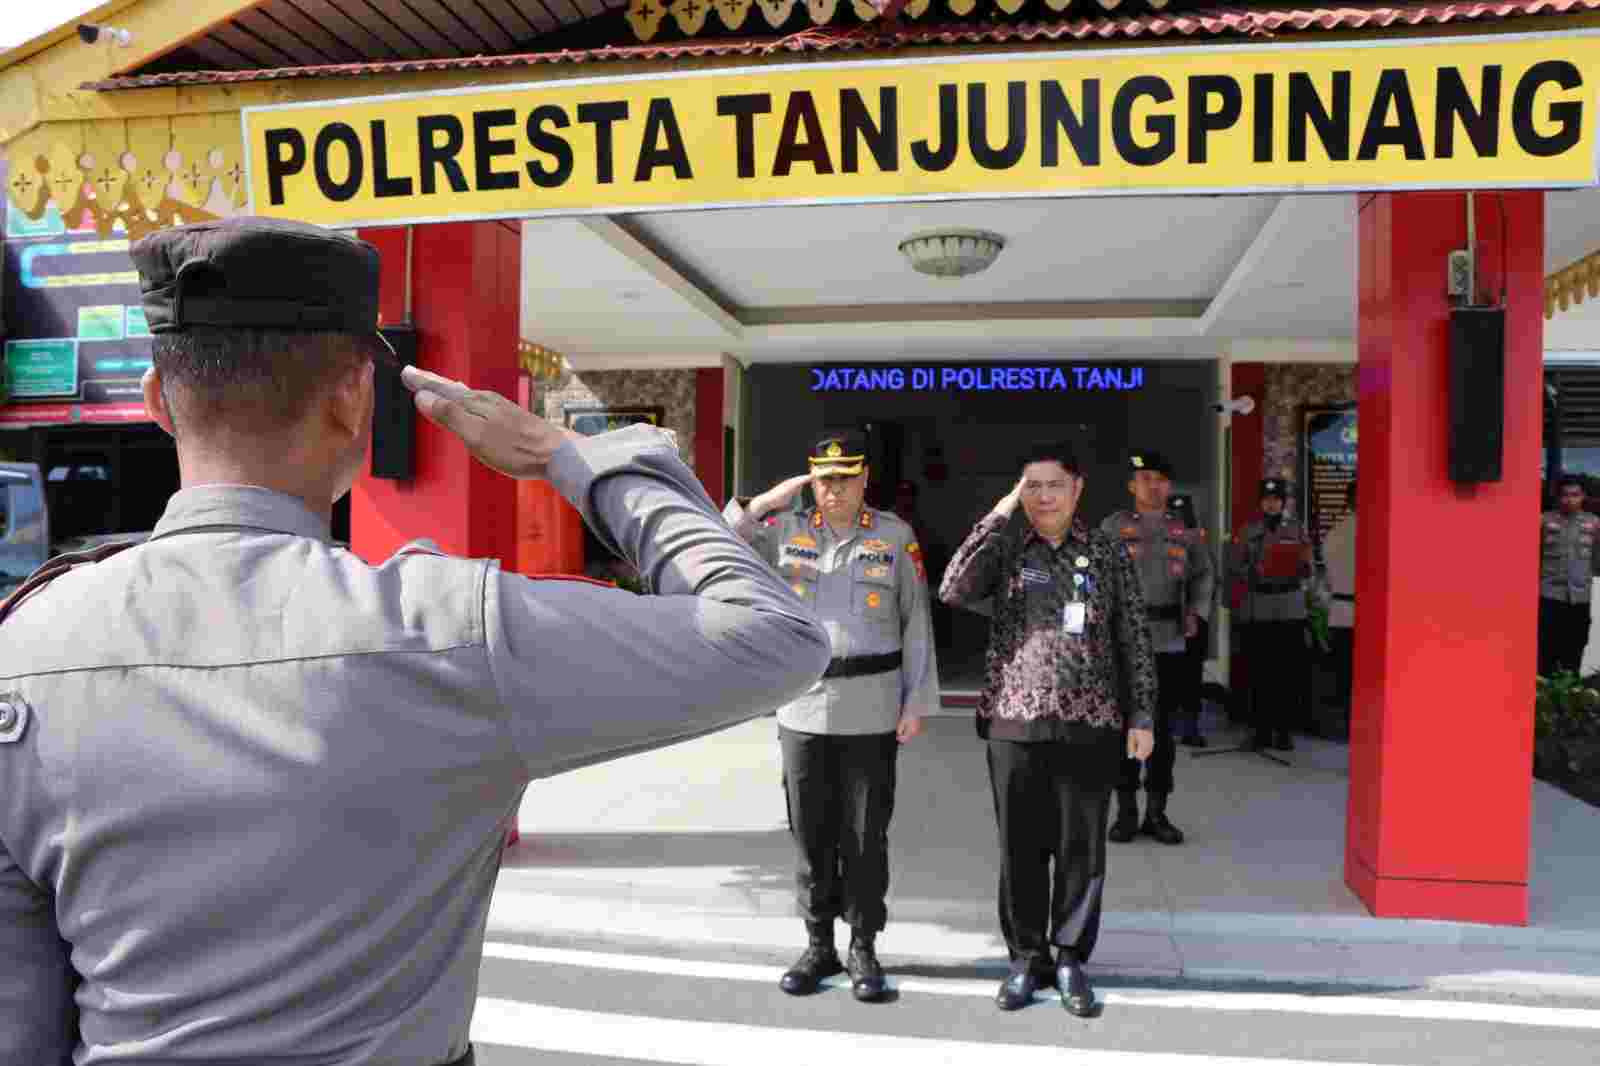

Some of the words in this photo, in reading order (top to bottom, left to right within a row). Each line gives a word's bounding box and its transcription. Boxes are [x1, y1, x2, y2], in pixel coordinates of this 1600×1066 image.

[265, 98, 693, 205] POLRESTA
[717, 61, 1582, 178] TANJUNGPINANG
[912, 368, 935, 391] DI
[943, 368, 1067, 391] POLRESTA
